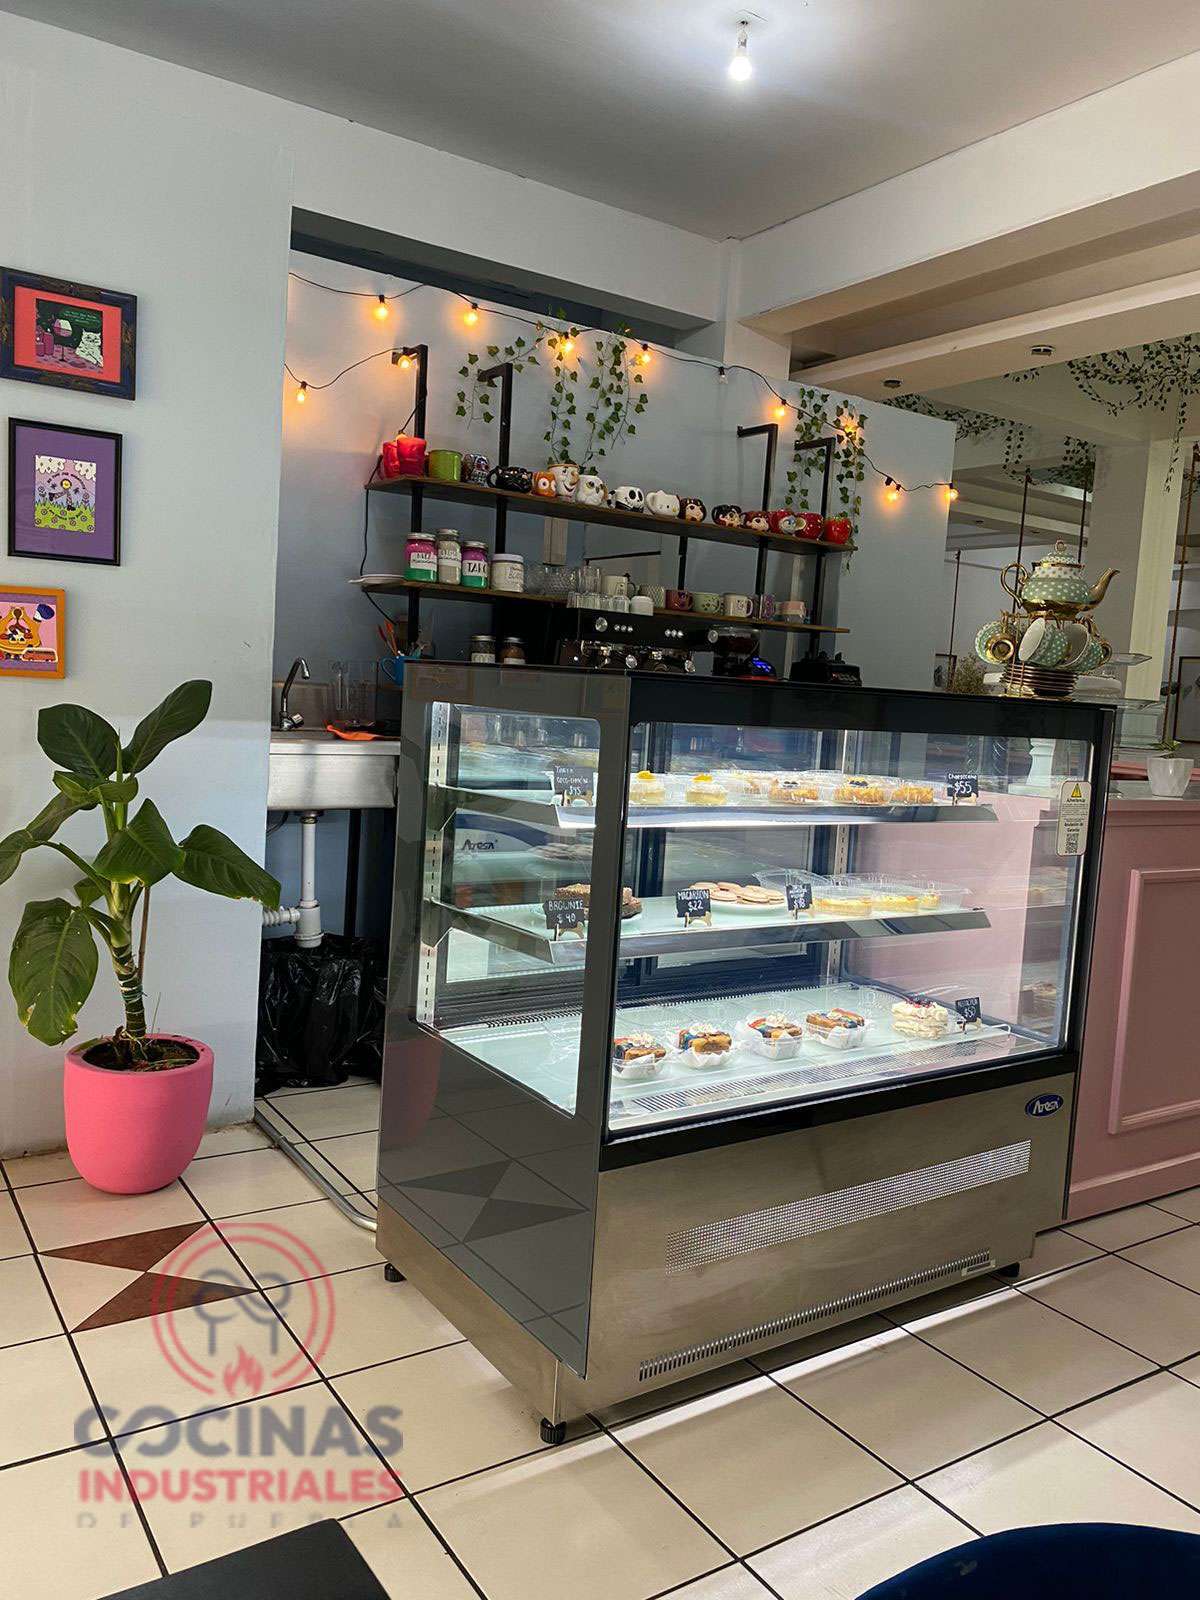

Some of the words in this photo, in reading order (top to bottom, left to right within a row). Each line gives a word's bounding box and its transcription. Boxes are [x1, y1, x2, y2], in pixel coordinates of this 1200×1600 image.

[954, 780, 972, 794] $55
[548, 900, 584, 911] BROWNIE
[687, 899, 704, 912] $22
